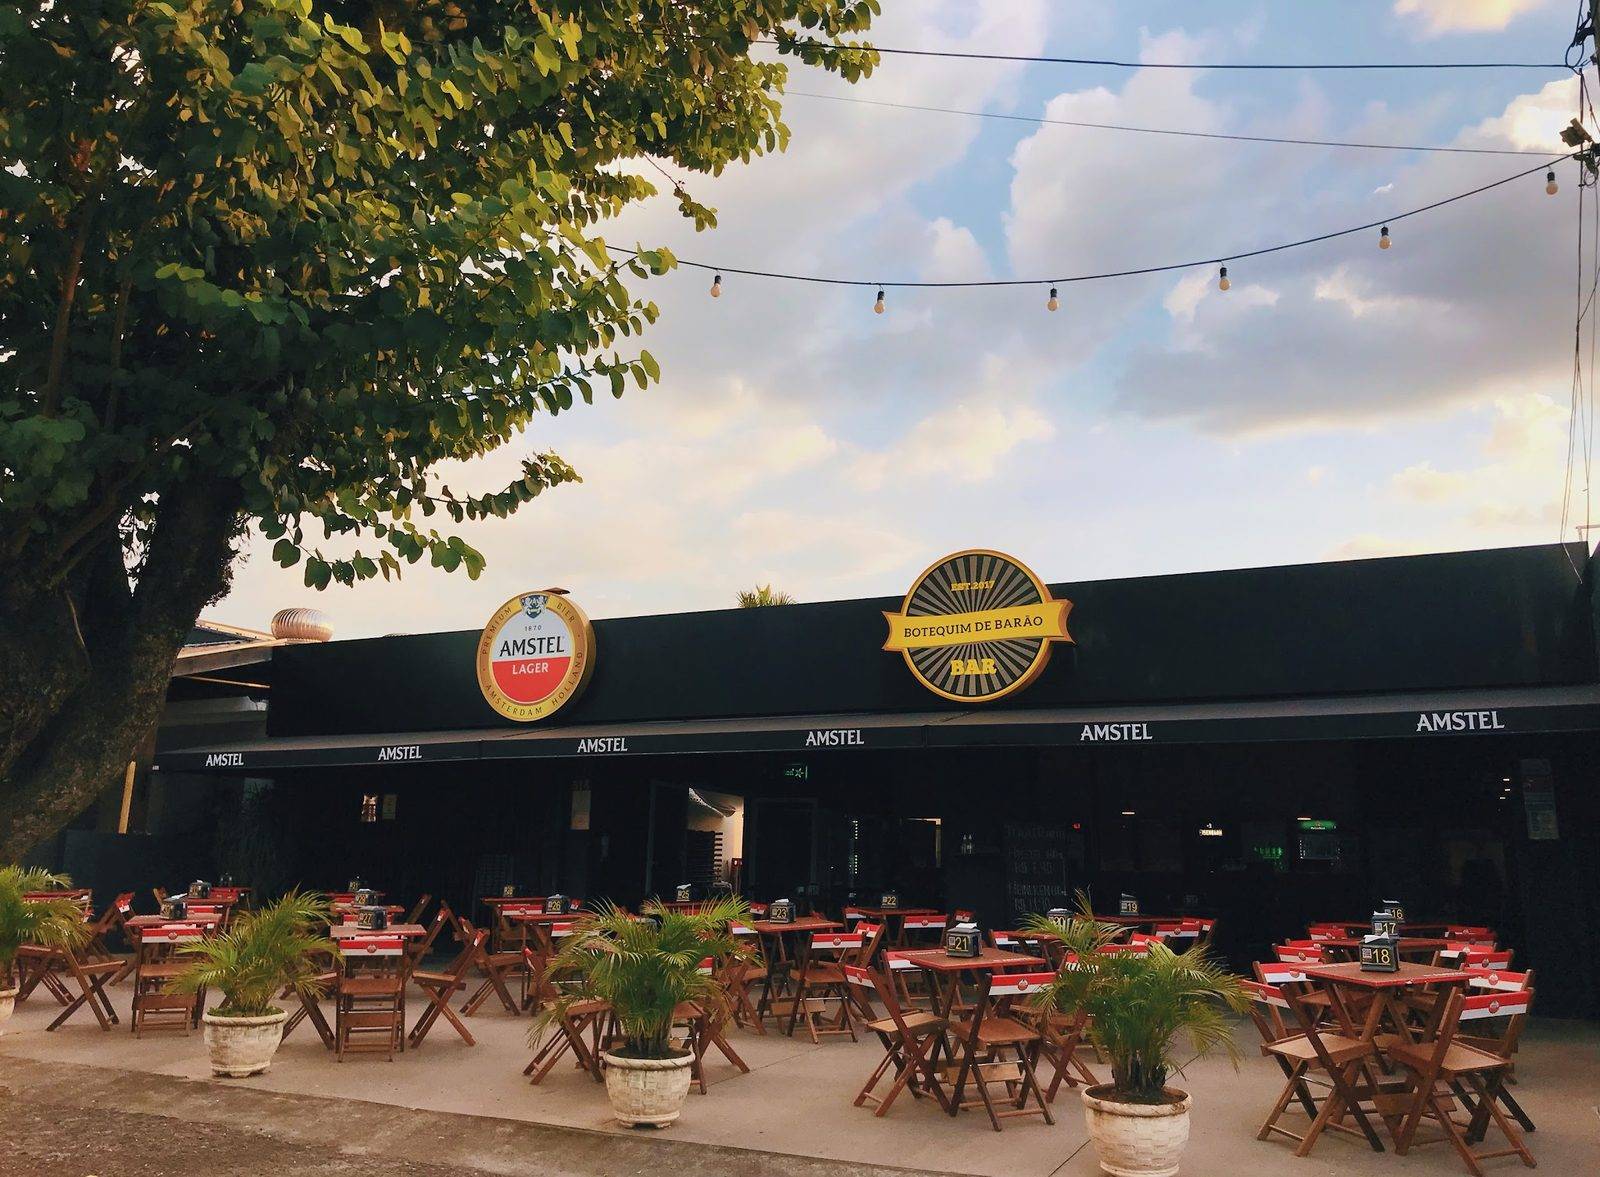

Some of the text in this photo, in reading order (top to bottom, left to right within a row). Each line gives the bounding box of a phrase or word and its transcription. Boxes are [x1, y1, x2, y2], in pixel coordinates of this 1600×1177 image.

[482, 602, 575, 655] PREMIUM BIER
[524, 624, 542, 632] 1870
[903, 614, 1044, 639] BOTEQUIM DE BARÃO
[499, 635, 565, 657] AMSTEL
[512, 662, 549, 675] LAGER
[950, 658, 997, 676] BAR
[484, 652, 583, 716] AMSTERDAM HOLLAND
[1416, 710, 1505, 732] AMSTEL
[805, 729, 865, 746] AMSTEL
[1080, 723, 1153, 741] AMSTEL
[378, 745, 423, 761] AMSTEL
[577, 737, 628, 753] AMSTEL
[205, 752, 245, 767] AMSTEL
[887, 896, 897, 906] 22
[1127, 902, 1138, 912] 19
[776, 907, 787, 918] 23
[1391, 909, 1403, 919] 16
[1383, 922, 1396, 934] 17
[955, 936, 968, 950] 21
[1373, 948, 1390, 964] 18
